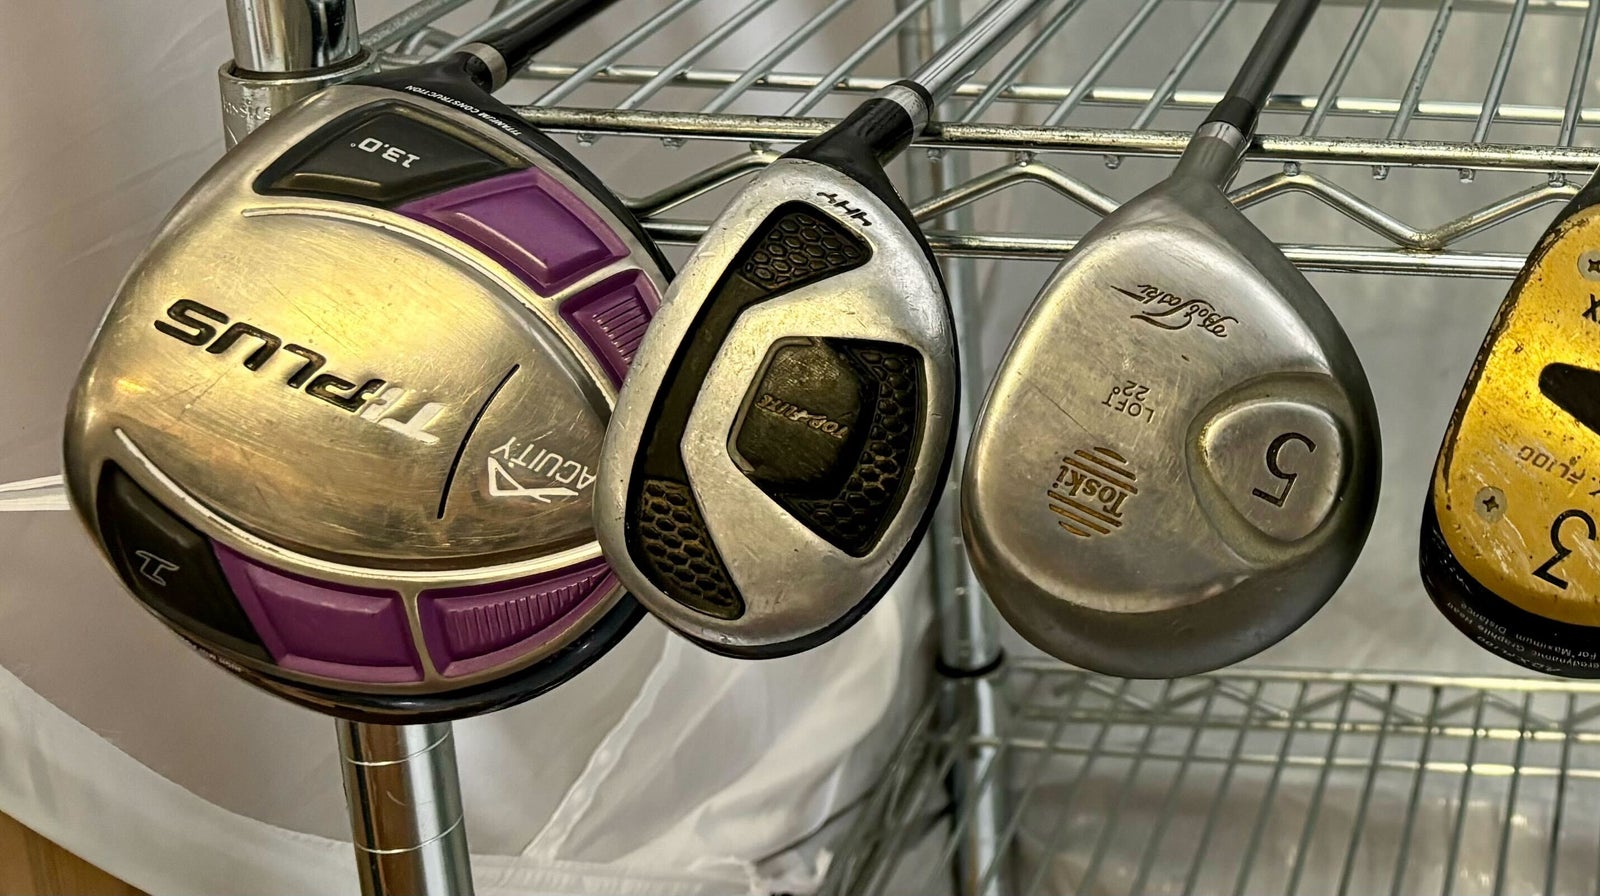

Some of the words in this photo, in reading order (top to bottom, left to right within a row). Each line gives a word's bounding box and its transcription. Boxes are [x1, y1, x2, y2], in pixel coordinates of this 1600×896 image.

[404, 84, 480, 117] CONSTRUCTION
[477, 105, 522, 137] TITANIUM
[1101, 394, 1155, 424] LOFT
[491, 436, 597, 491] ACUITY
[1251, 432, 1317, 508] 5
[1055, 465, 1130, 518] Toski
[1532, 509, 1597, 590] 3
[1461, 602, 1507, 635] Distance
[1516, 633, 1571, 656] Maximum
[1577, 651, 1598, 661] For
